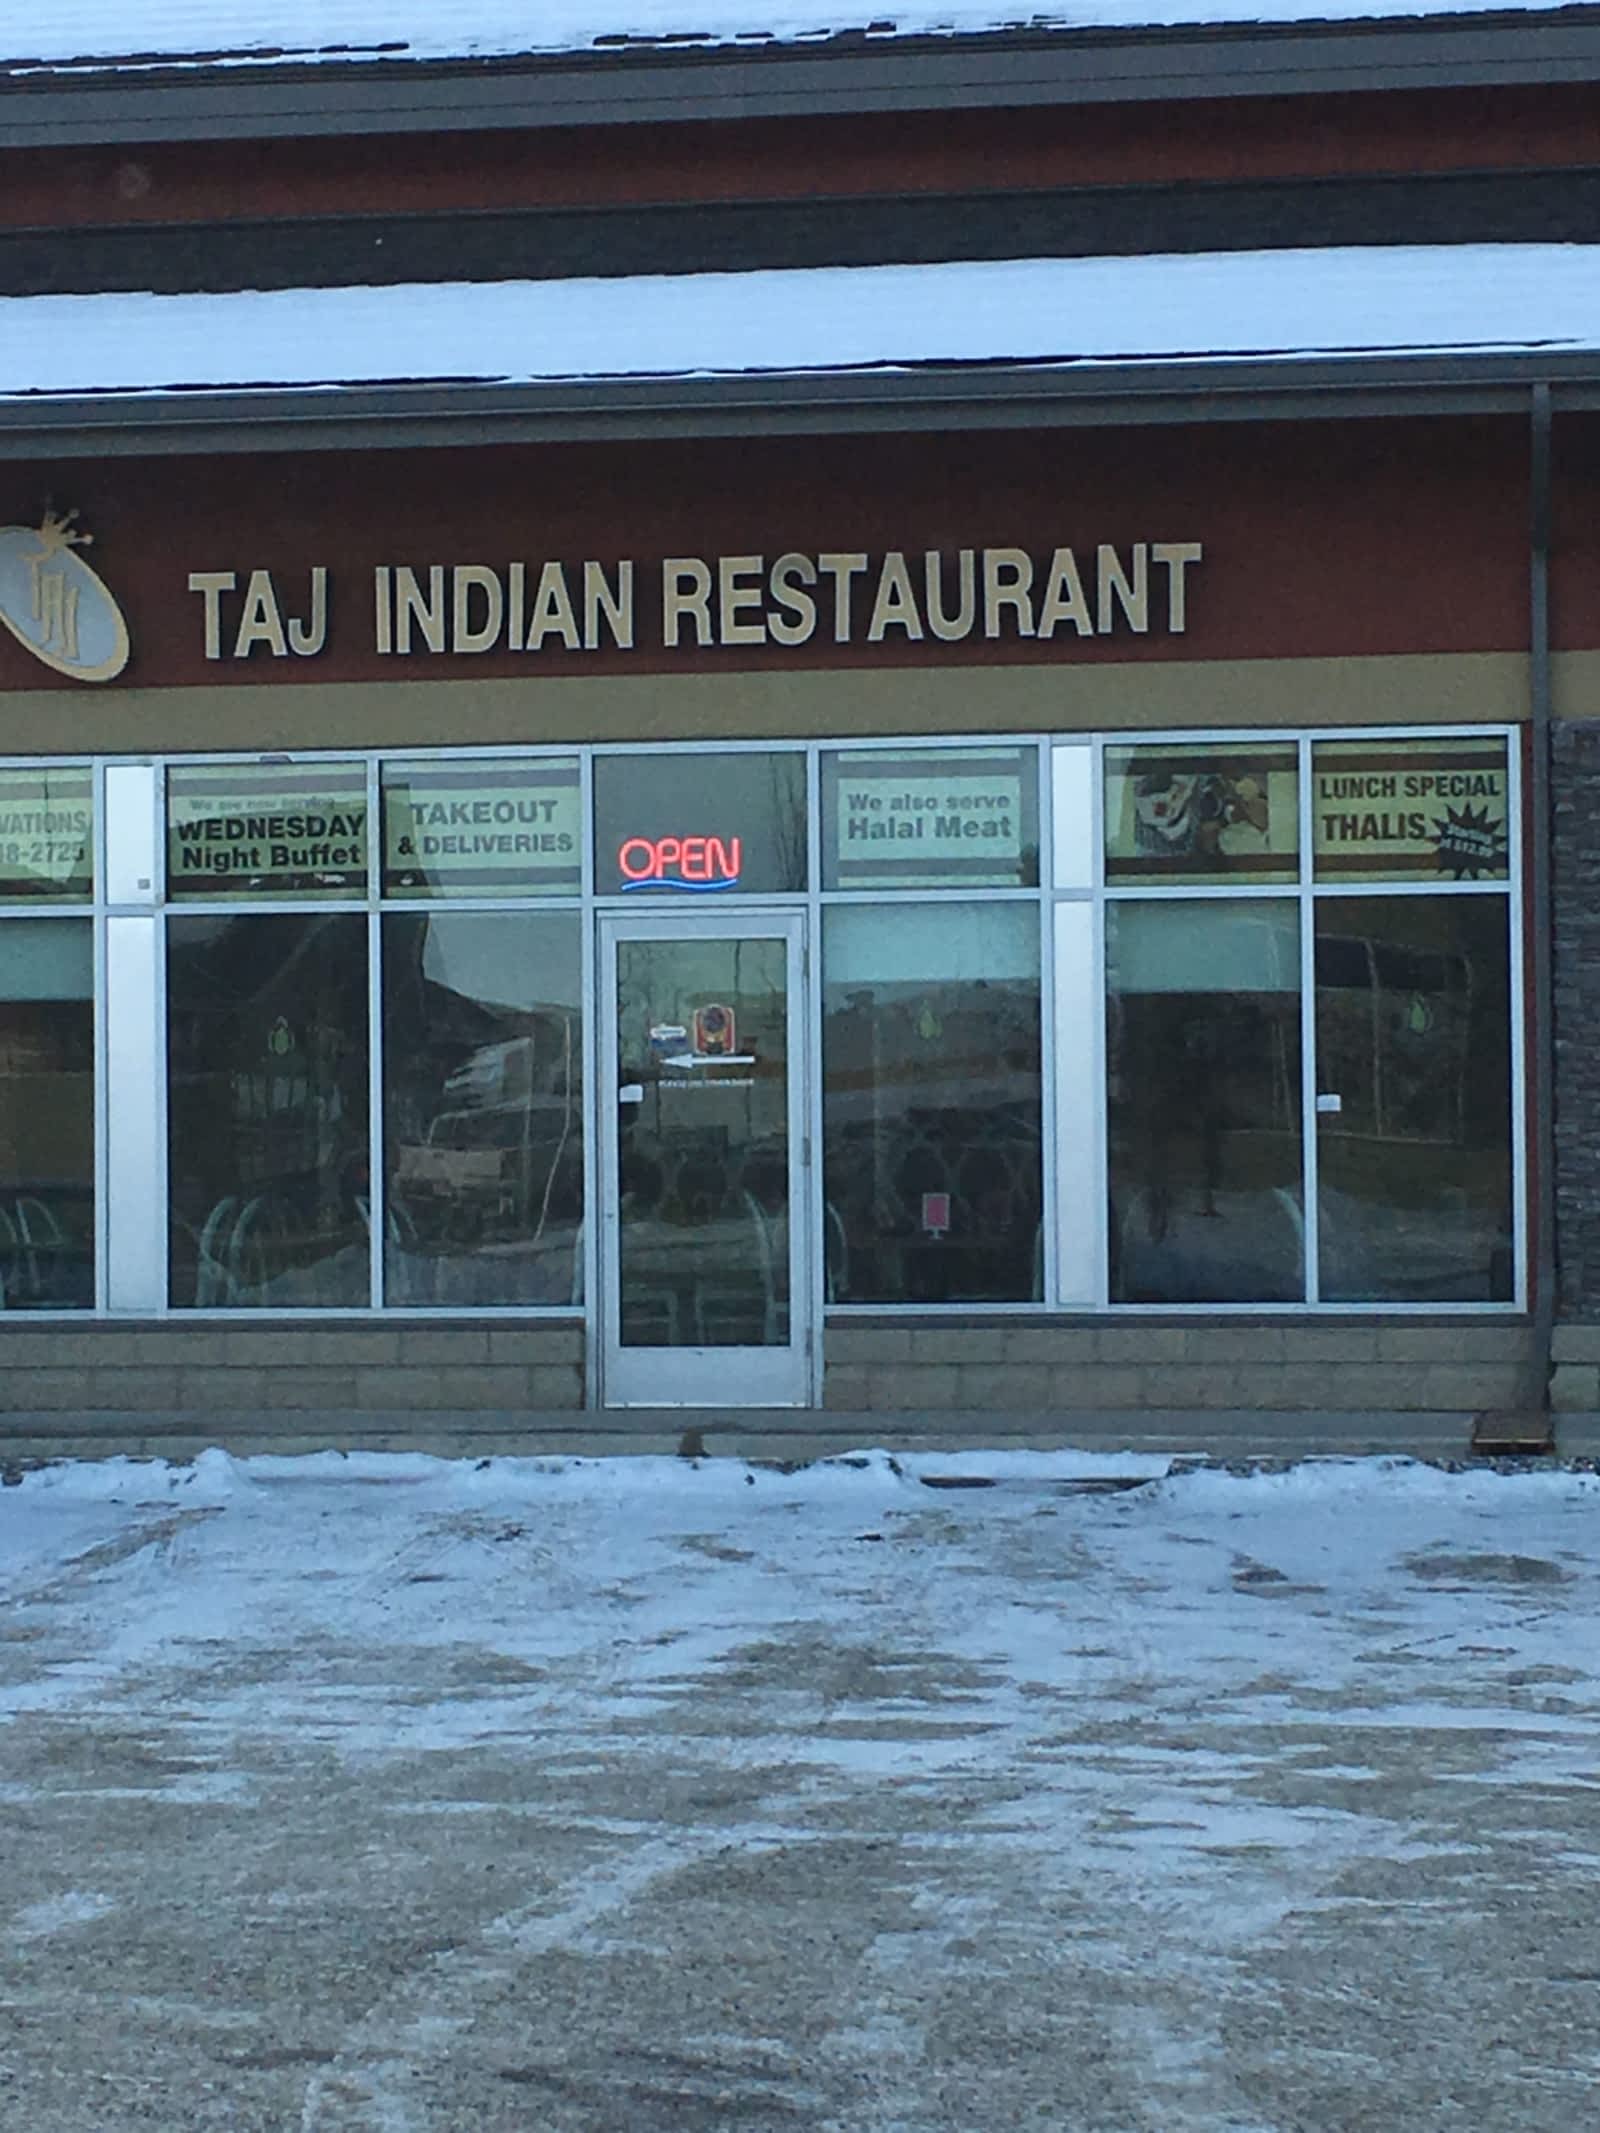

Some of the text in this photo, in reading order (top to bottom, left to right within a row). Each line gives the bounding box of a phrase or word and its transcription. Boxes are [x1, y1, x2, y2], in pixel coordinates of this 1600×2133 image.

[187, 542, 1203, 659] TAJ INDIAN RESTAURANT
[1320, 775, 1500, 799] LUNCH SPECIAL
[410, 799, 558, 825] TAKEOUT
[847, 793, 1010, 811] We also serve
[178, 814, 366, 841] WEDNESDAY
[848, 816, 1012, 840] Halal Meat
[1322, 812, 1427, 841] THALIS
[398, 833, 573, 855] & DELIVERIES
[182, 843, 361, 873] Night Buffet
[619, 836, 741, 879] OPEN
